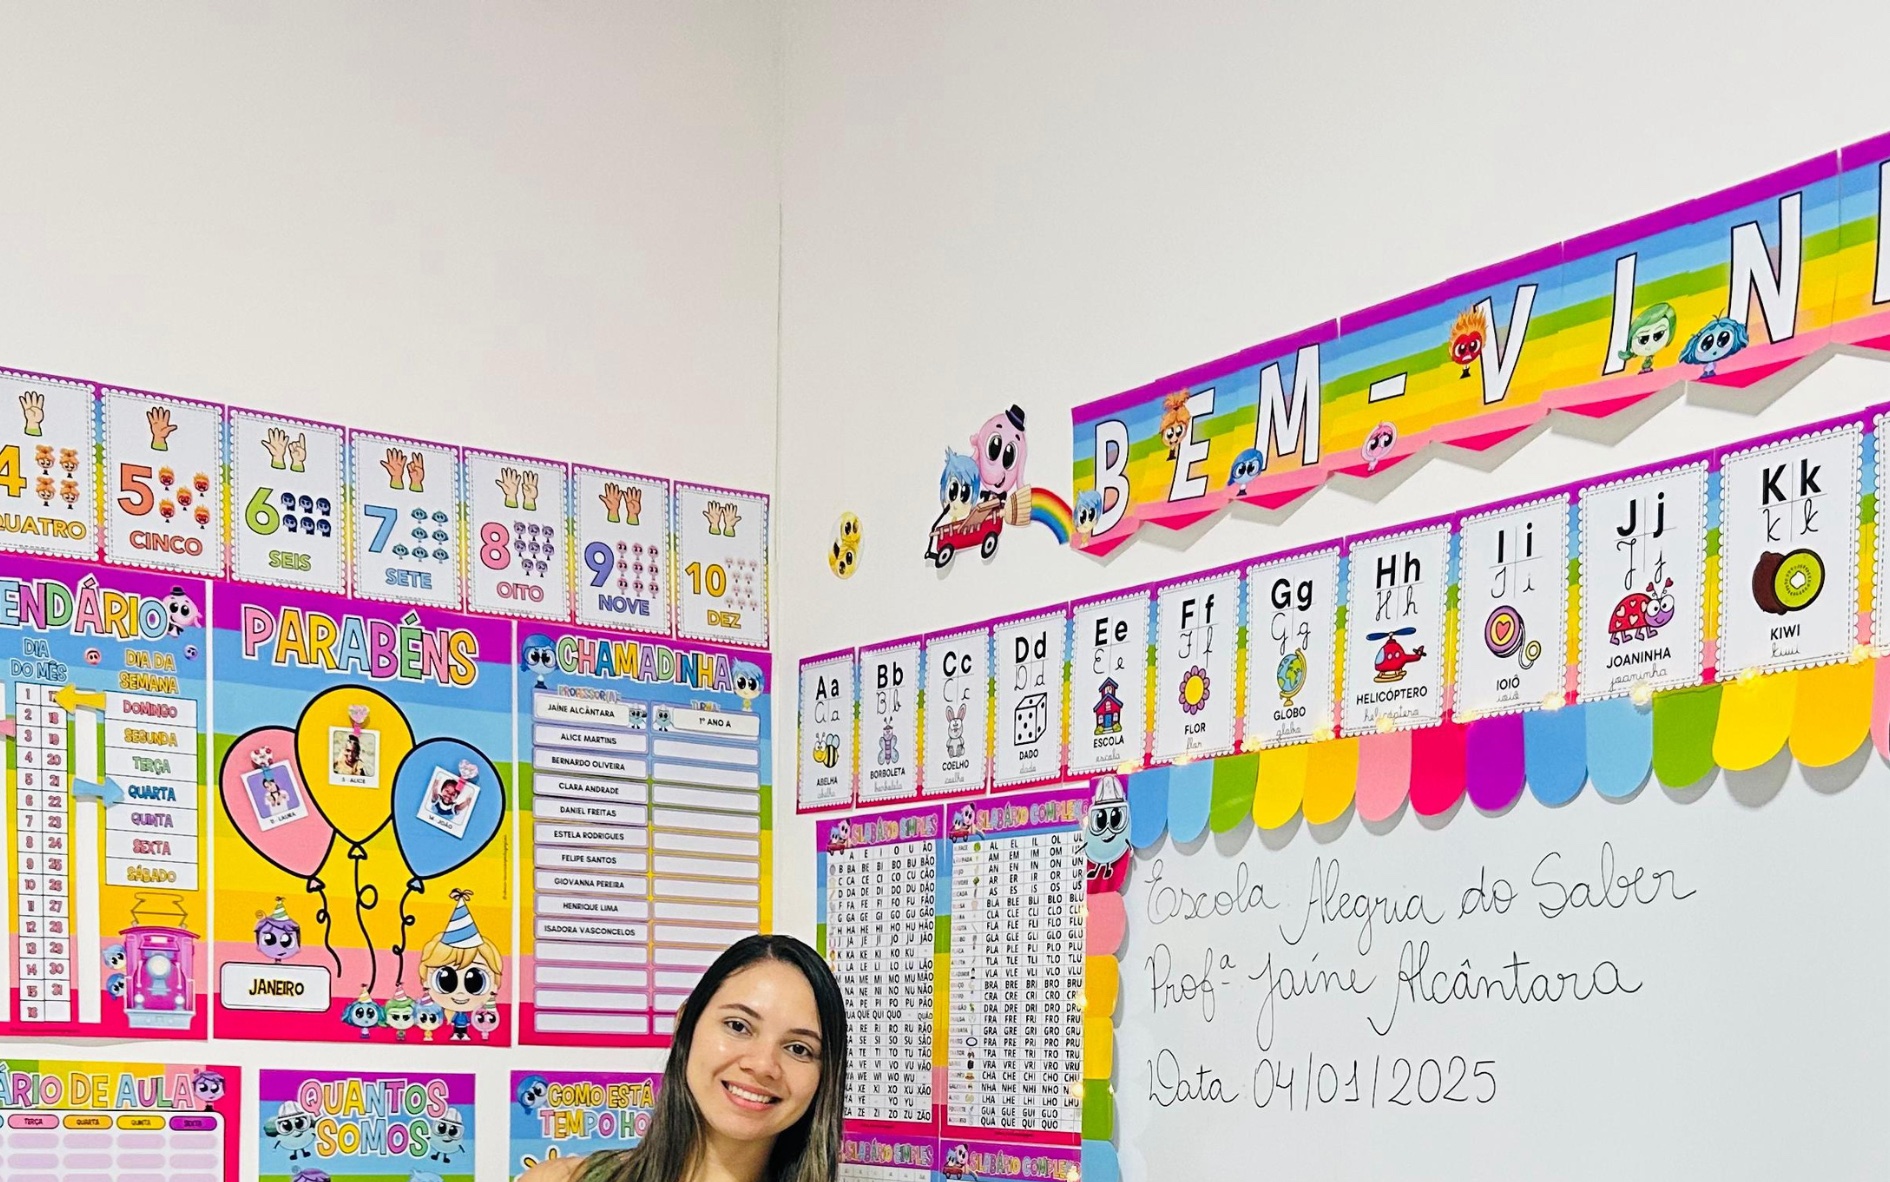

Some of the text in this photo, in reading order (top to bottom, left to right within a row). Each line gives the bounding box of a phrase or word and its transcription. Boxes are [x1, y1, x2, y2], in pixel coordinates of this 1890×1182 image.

[0, 445, 27, 497] 4
[118, 463, 155, 516] 5
[245, 487, 280, 535] 6
[0, 513, 87, 540] UATRO
[364, 504, 397, 553] 7
[129, 530, 203, 556] CINCO
[480, 522, 511, 570] 8
[269, 550, 312, 571] SEIS
[584, 541, 615, 587] 9
[386, 568, 432, 589] SETE
[685, 561, 727, 597] 10
[496, 581, 544, 602] OITO
[599, 594, 650, 616] NOVE
[707, 610, 742, 629] DEZ
[1770, 624, 1801, 640] KIWI
[24, 639, 49, 657] DIA
[243, 613, 478, 686] PARABÉNS
[125, 649, 175, 670] DIA DA
[558, 637, 732, 691] CHAMADINHA
[1606, 647, 1671, 669] JOANINHA
[11, 660, 67, 681] DO MÊS
[119, 672, 178, 694] SEMANA
[1496, 674, 1520, 690] IOIÔ
[1356, 686, 1427, 705] HELICÓPTERO
[123, 700, 178, 718] DOMINGO
[570, 705, 615, 718] ALCÂNTARA
[1273, 706, 1306, 721] GLOBO
[707, 719, 723, 727] ANO
[1184, 723, 1206, 735] FLOR
[561, 733, 617, 744] ALICE MARTINS
[1094, 735, 1124, 749] ESCOLA
[552, 757, 625, 771] BERNARDO OLIVEIRA
[1019, 749, 1038, 761] DADO
[132, 756, 171, 775] TERÇA
[870, 768, 905, 779] BORBOLETA
[942, 760, 969, 771] COELHO
[559, 782, 619, 795] CLARA ANDRADE
[816, 776, 838, 786] ABELHA
[128, 785, 176, 801] QUARTA
[131, 813, 174, 828] QUINTA
[560, 806, 616, 817] DANIEL FREITAS
[554, 831, 624, 840] ESTELA RODRIGUES
[990, 835, 1061, 850] AL EL IL OL
[133, 839, 171, 855] SEXTA
[562, 854, 617, 864] FELIPE SANTOS
[127, 865, 176, 883] SÁBADO
[554, 878, 624, 889] GIOVANNA PEREIRA
[563, 902, 618, 912] HENRIQUE LIMA
[1145, 841, 1696, 956] Escola Alegria do Saber
[544, 925, 635, 936] ISADORA VASCONCELOS
[249, 978, 304, 996] JANEIRO
[985, 978, 1082, 990] BRA BRE BRI BRO BRU
[1249, 951, 1377, 1052] Jaíne
[1367, 940, 1643, 1036] Alcântara
[1147, 1048, 1496, 1112] Data 04/01/2025
[71, 1073, 108, 1108] DE
[116, 1074, 194, 1108] AULA
[301, 1080, 446, 1118] QUANTOS
[550, 1080, 654, 1108] COMO ESTÁ
[540, 1109, 649, 1138] TEMPO HO
[317, 1119, 428, 1157] SOMOS
